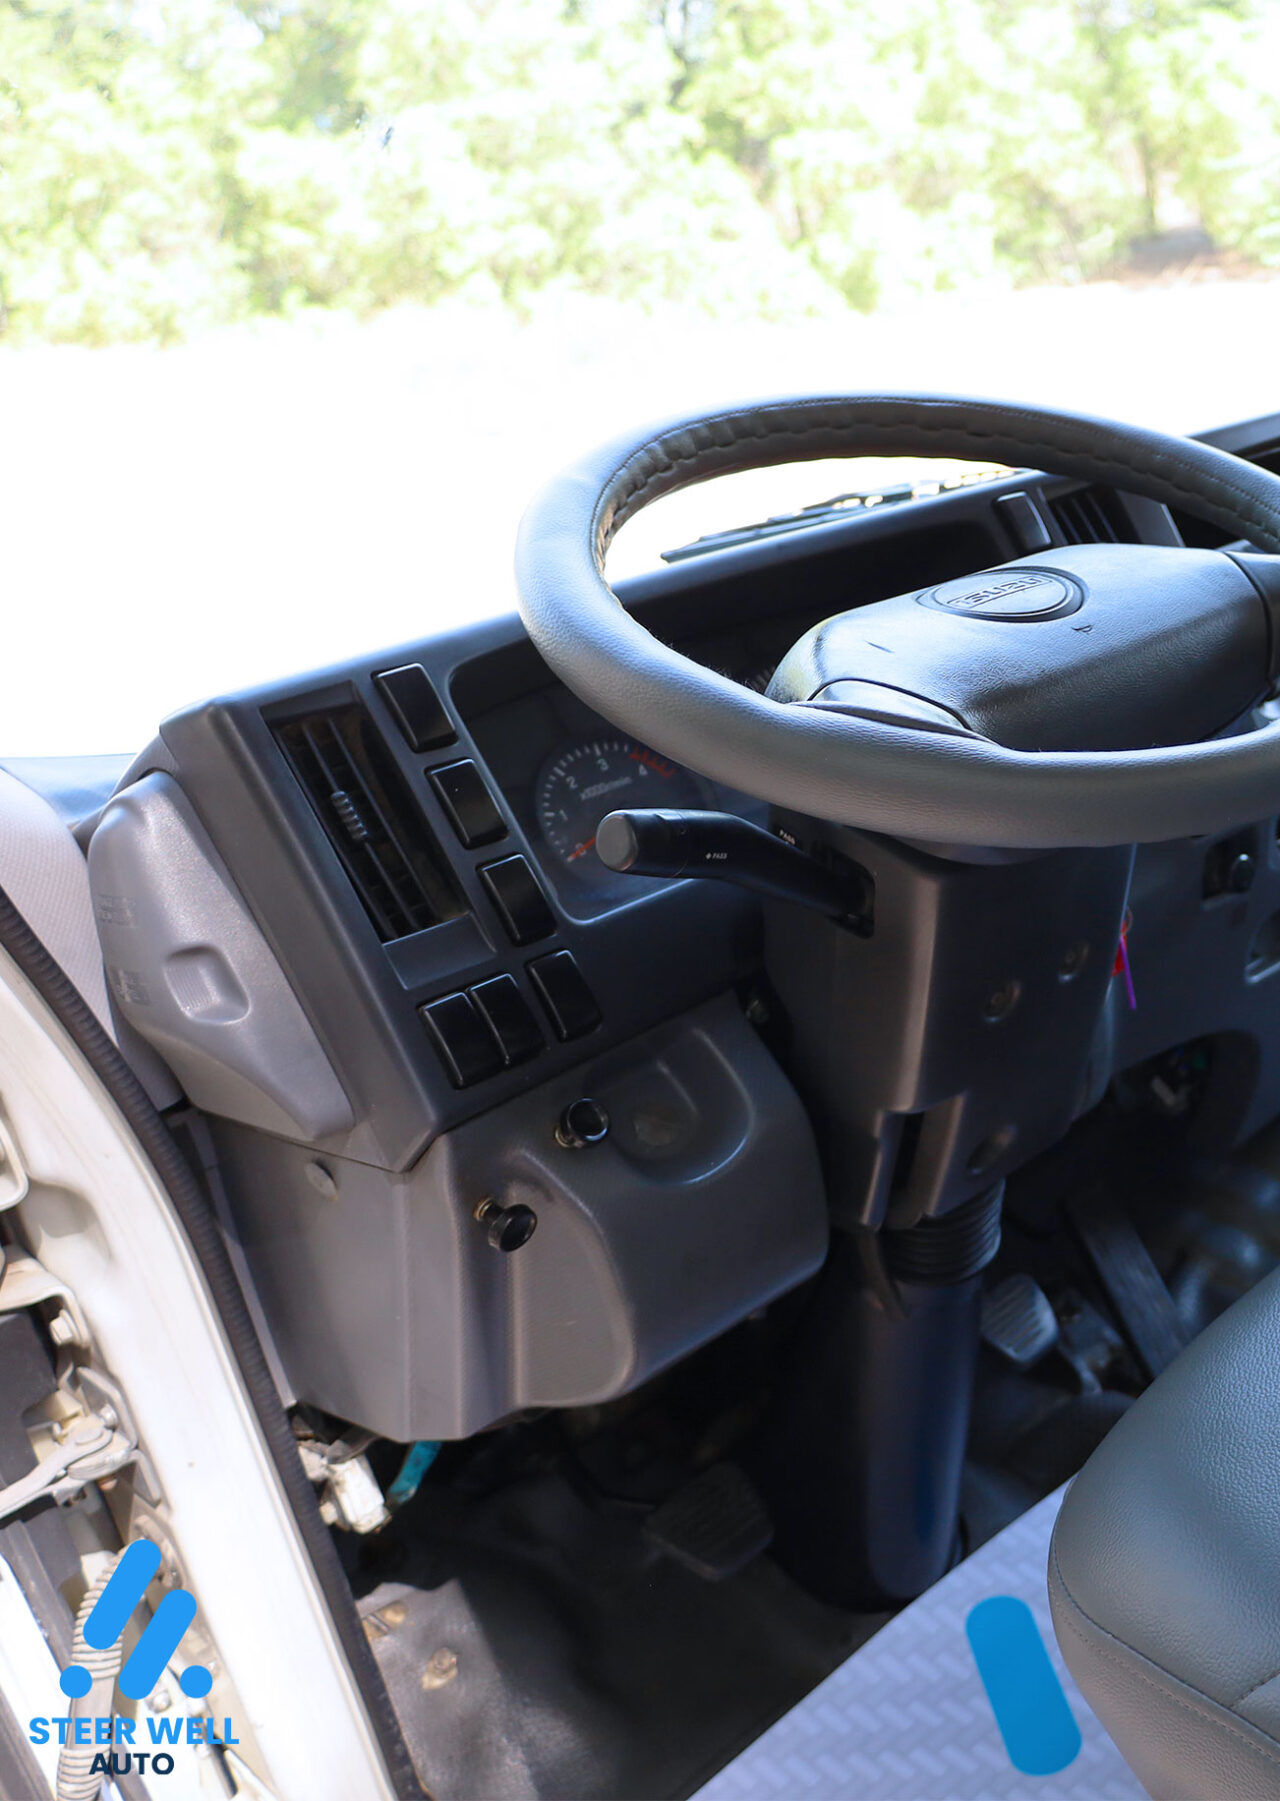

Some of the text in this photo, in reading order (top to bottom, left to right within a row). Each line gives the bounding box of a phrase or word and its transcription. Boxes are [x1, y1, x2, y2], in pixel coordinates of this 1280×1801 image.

[955, 577, 1042, 606] ISUZU
[597, 758, 609, 772] 3
[638, 764, 648, 776] 4
[566, 775, 579, 789] 2
